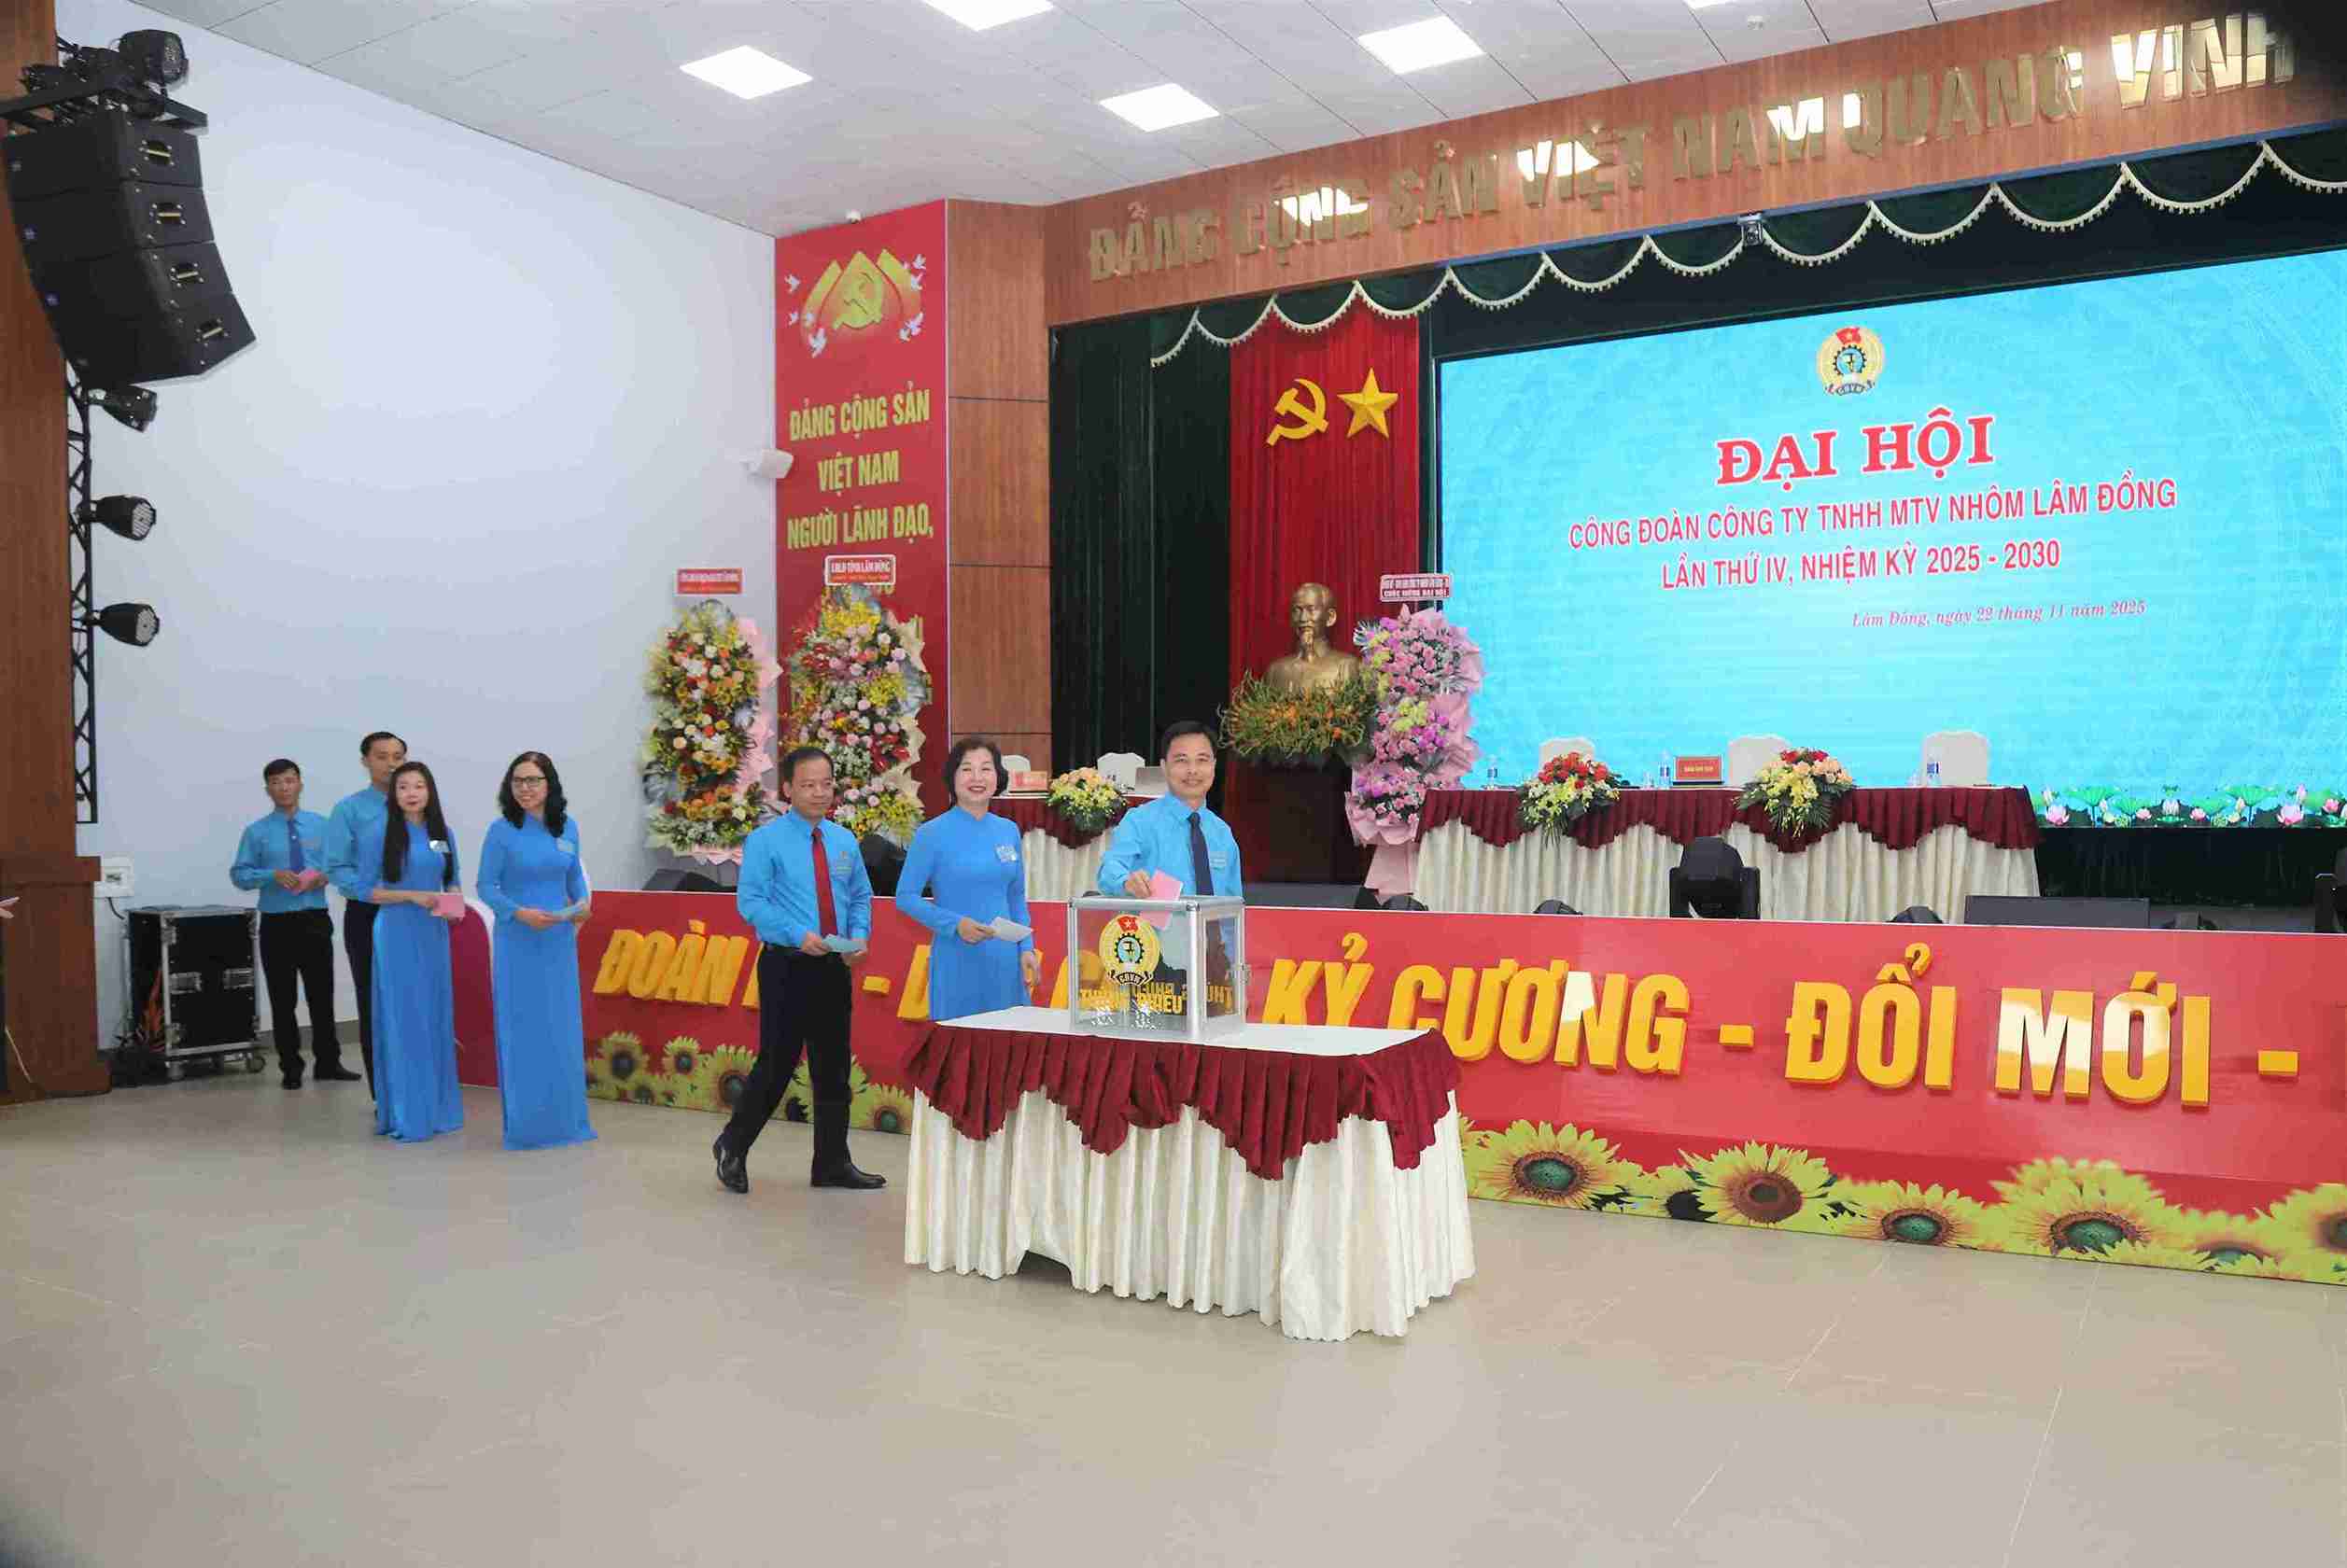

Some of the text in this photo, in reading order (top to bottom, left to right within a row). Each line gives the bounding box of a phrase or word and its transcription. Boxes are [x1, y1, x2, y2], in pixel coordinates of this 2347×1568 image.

[1089, 13, 2295, 283] ĐẢNG CỘNG SẢN VIỆT NAM QUANG VINH
[790, 380, 930, 441] ĐẢNG CỘNG SẢN
[817, 449, 899, 497] VIỆT NAM
[1716, 407, 1993, 491] ĐẠI HỘI
[787, 502, 934, 550] NGƯỜI LÃNH ĐẠO,
[1569, 467, 2177, 549] CÔNG ĐOÀN CÔNG TY TNHH MTV NHÔM LÂM ĐỒNG
[1662, 539, 2061, 589] LẦN THỨ IV, NHIỆM KỲ 2025 - 2030
[1976, 605, 1994, 622] 22
[2110, 598, 2147, 617] 2025
[592, 919, 750, 1007] ĐOÀN
[1261, 931, 1374, 1025] KỶ
[1387, 959, 1691, 1075] CƯƠNG
[1784, 942, 1958, 1091] ĐỔI
[1994, 971, 2212, 1109] MỚI
